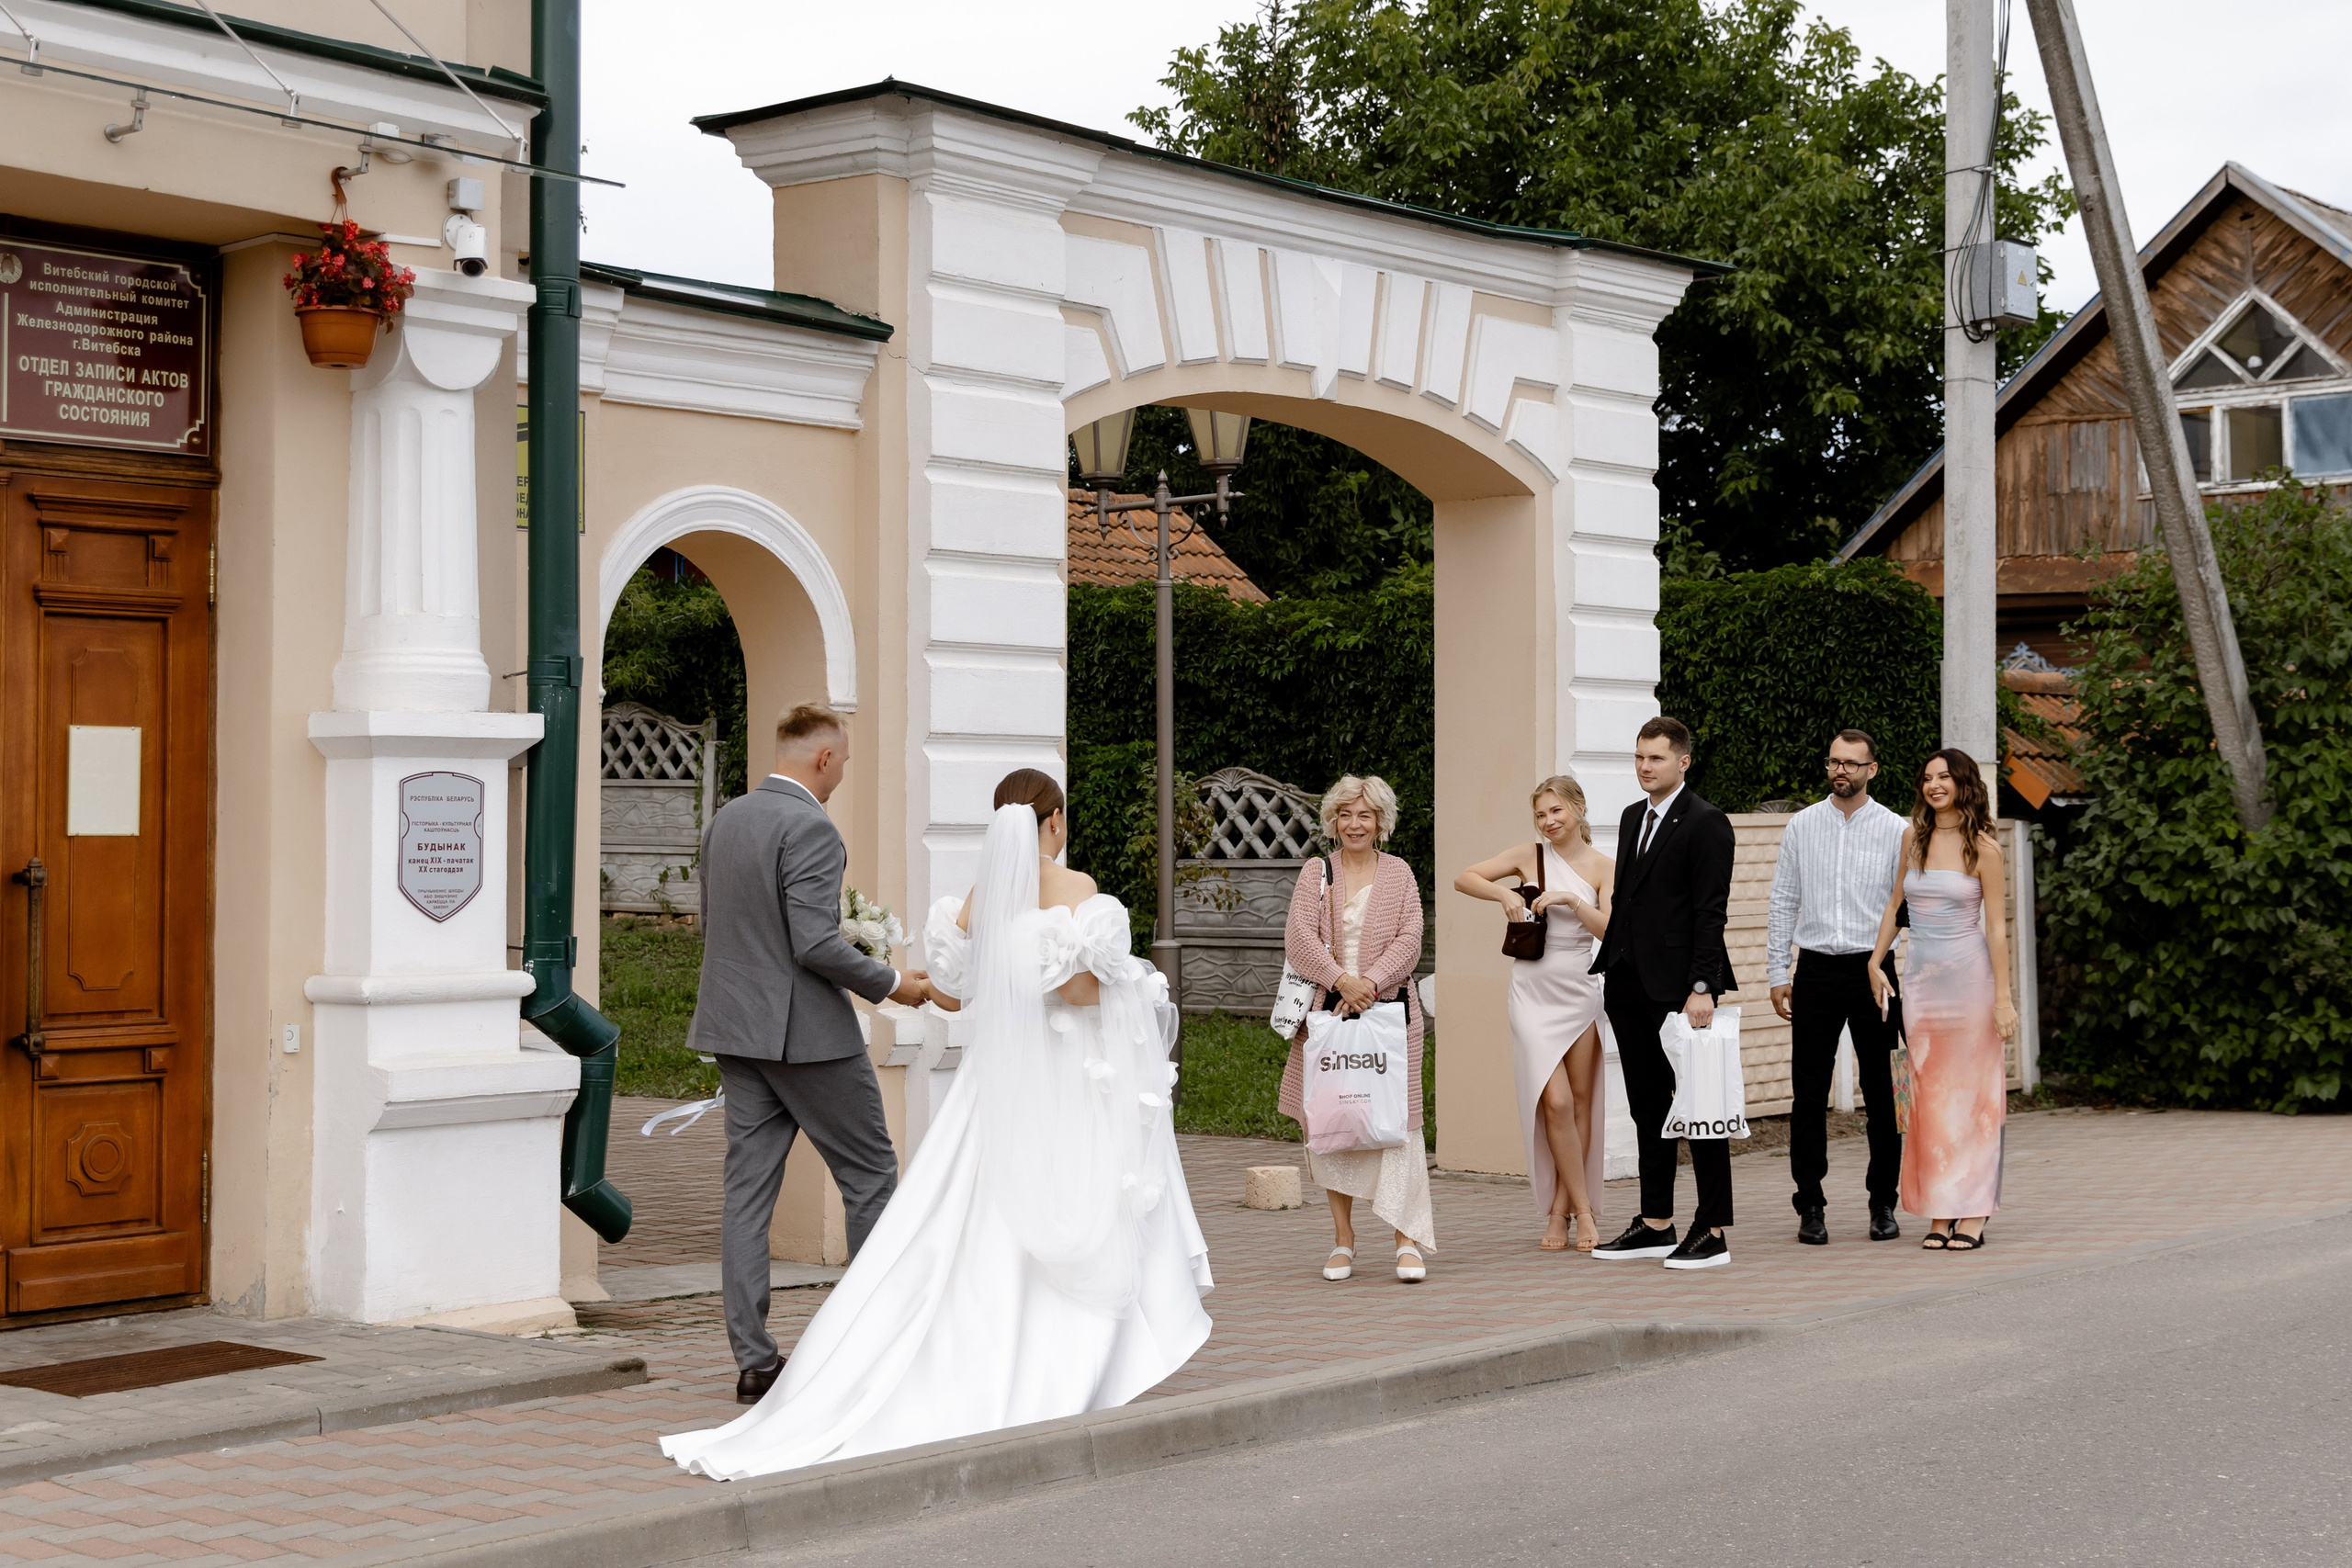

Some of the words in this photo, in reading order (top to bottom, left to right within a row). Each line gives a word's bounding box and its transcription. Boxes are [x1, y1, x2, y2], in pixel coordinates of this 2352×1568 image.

[43, 262, 109, 283] Витебский
[115, 275, 177, 292] городской
[29, 279, 137, 303] исполнительный
[141, 294, 190, 310] комитет
[55, 300, 159, 326] Администрация
[17, 312, 145, 341] Железнодорожного
[149, 330, 194, 346] района
[73, 337, 141, 356] г.Витебска
[18, 355, 70, 377] ОТДЕЛ
[75, 361, 136, 383] ЗАПИСИ
[141, 368, 189, 389] АКТОВ
[45, 380, 164, 408] ГРАЖДАНСКОГО
[59, 403, 150, 427] СОСТОЯНИЯ
[417, 842, 466, 852] БУДЫНАК
[1319, 1050, 1387, 1075] sinsay
